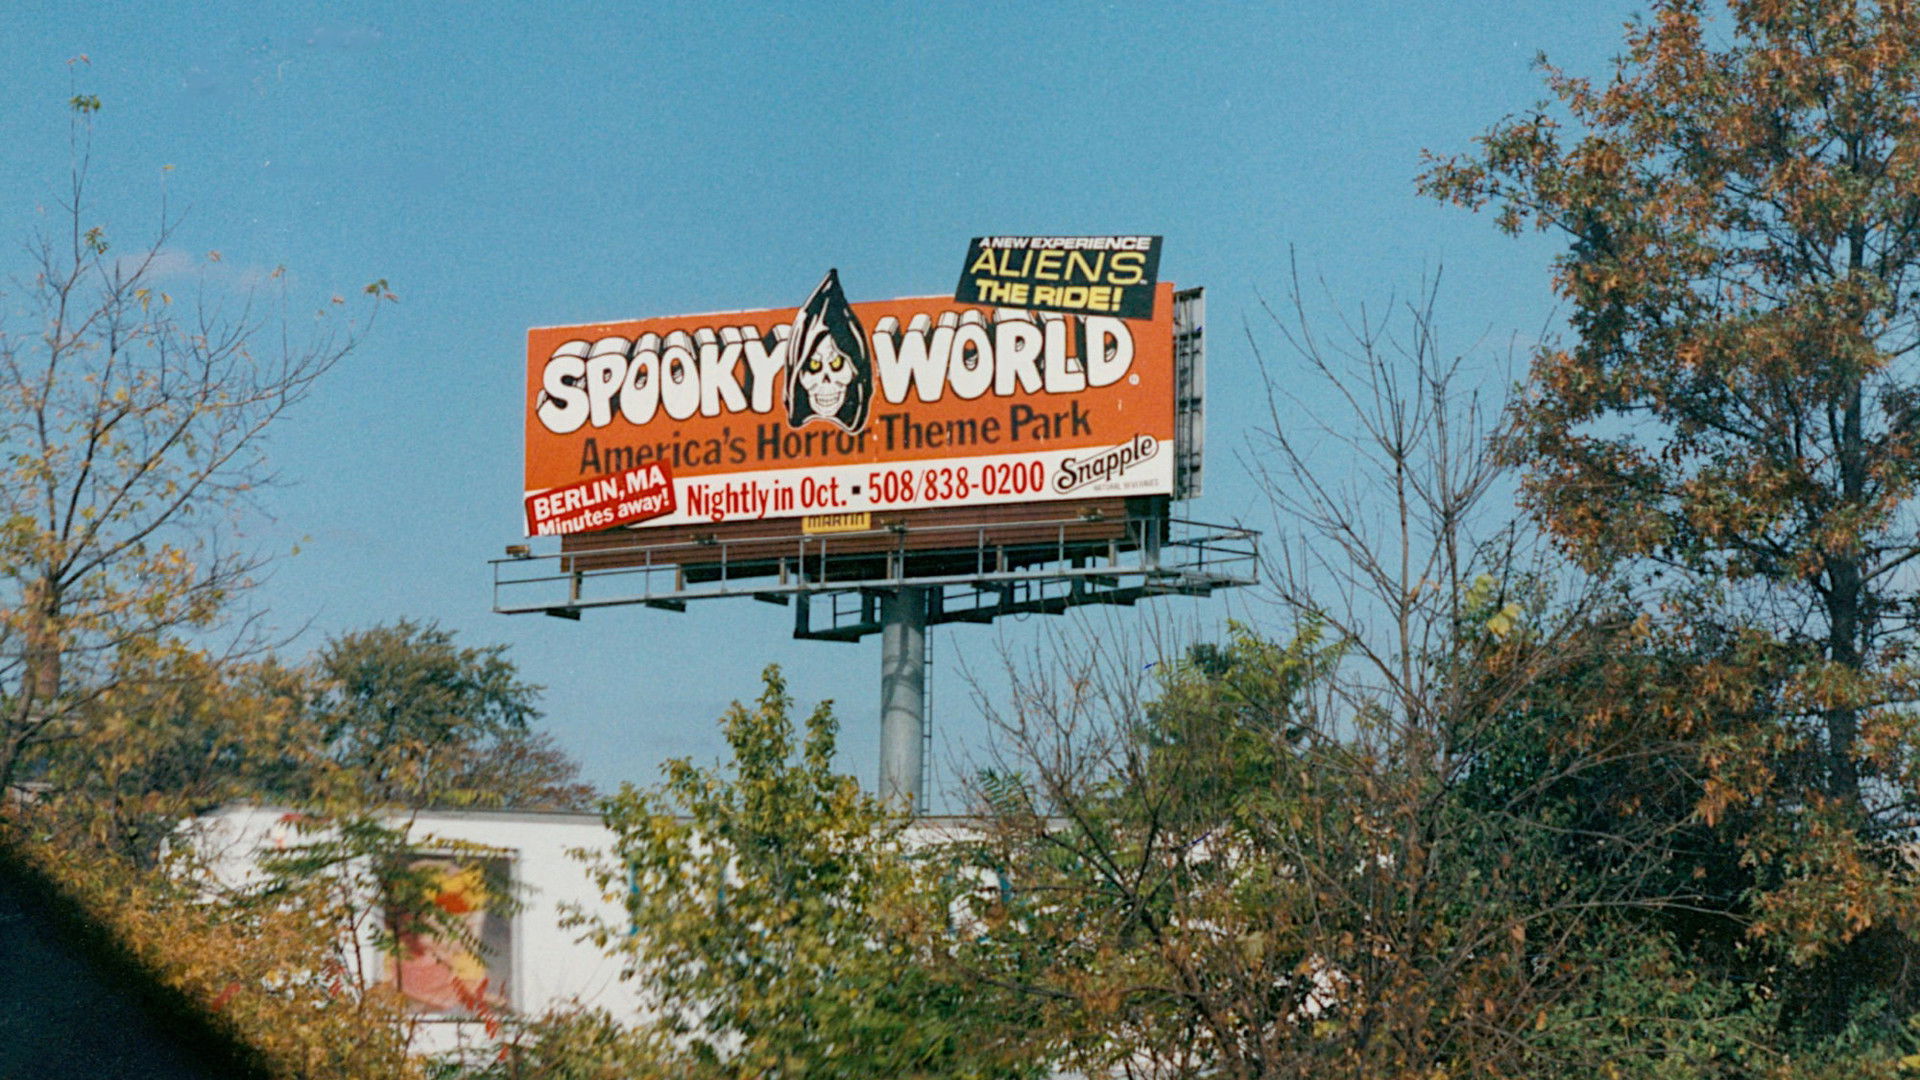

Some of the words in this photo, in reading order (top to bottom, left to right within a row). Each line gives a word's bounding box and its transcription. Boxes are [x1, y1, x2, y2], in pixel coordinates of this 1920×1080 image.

[970, 248, 1146, 285] ALIENS
[979, 237, 991, 248] A
[991, 237, 1029, 248] NEW
[1030, 237, 1152, 250] EXPERIENCE
[976, 279, 1029, 304] THE
[1033, 285, 1123, 312] RIDE!
[537, 325, 790, 433] SPOOKY
[872, 309, 1135, 404] WORLD
[579, 427, 747, 476] America's
[757, 421, 872, 461] Horror
[879, 412, 1000, 451] Theme
[1010, 400, 1092, 442] Park
[1057, 433, 1153, 490] Snapple
[625, 464, 667, 494] MA
[687, 480, 769, 521] Nightly
[774, 479, 794, 512] in
[800, 476, 848, 508] Oct.
[868, 460, 1045, 505] 508/838-0200
[536, 506, 615, 536] Minutes
[617, 487, 670, 519] away!
